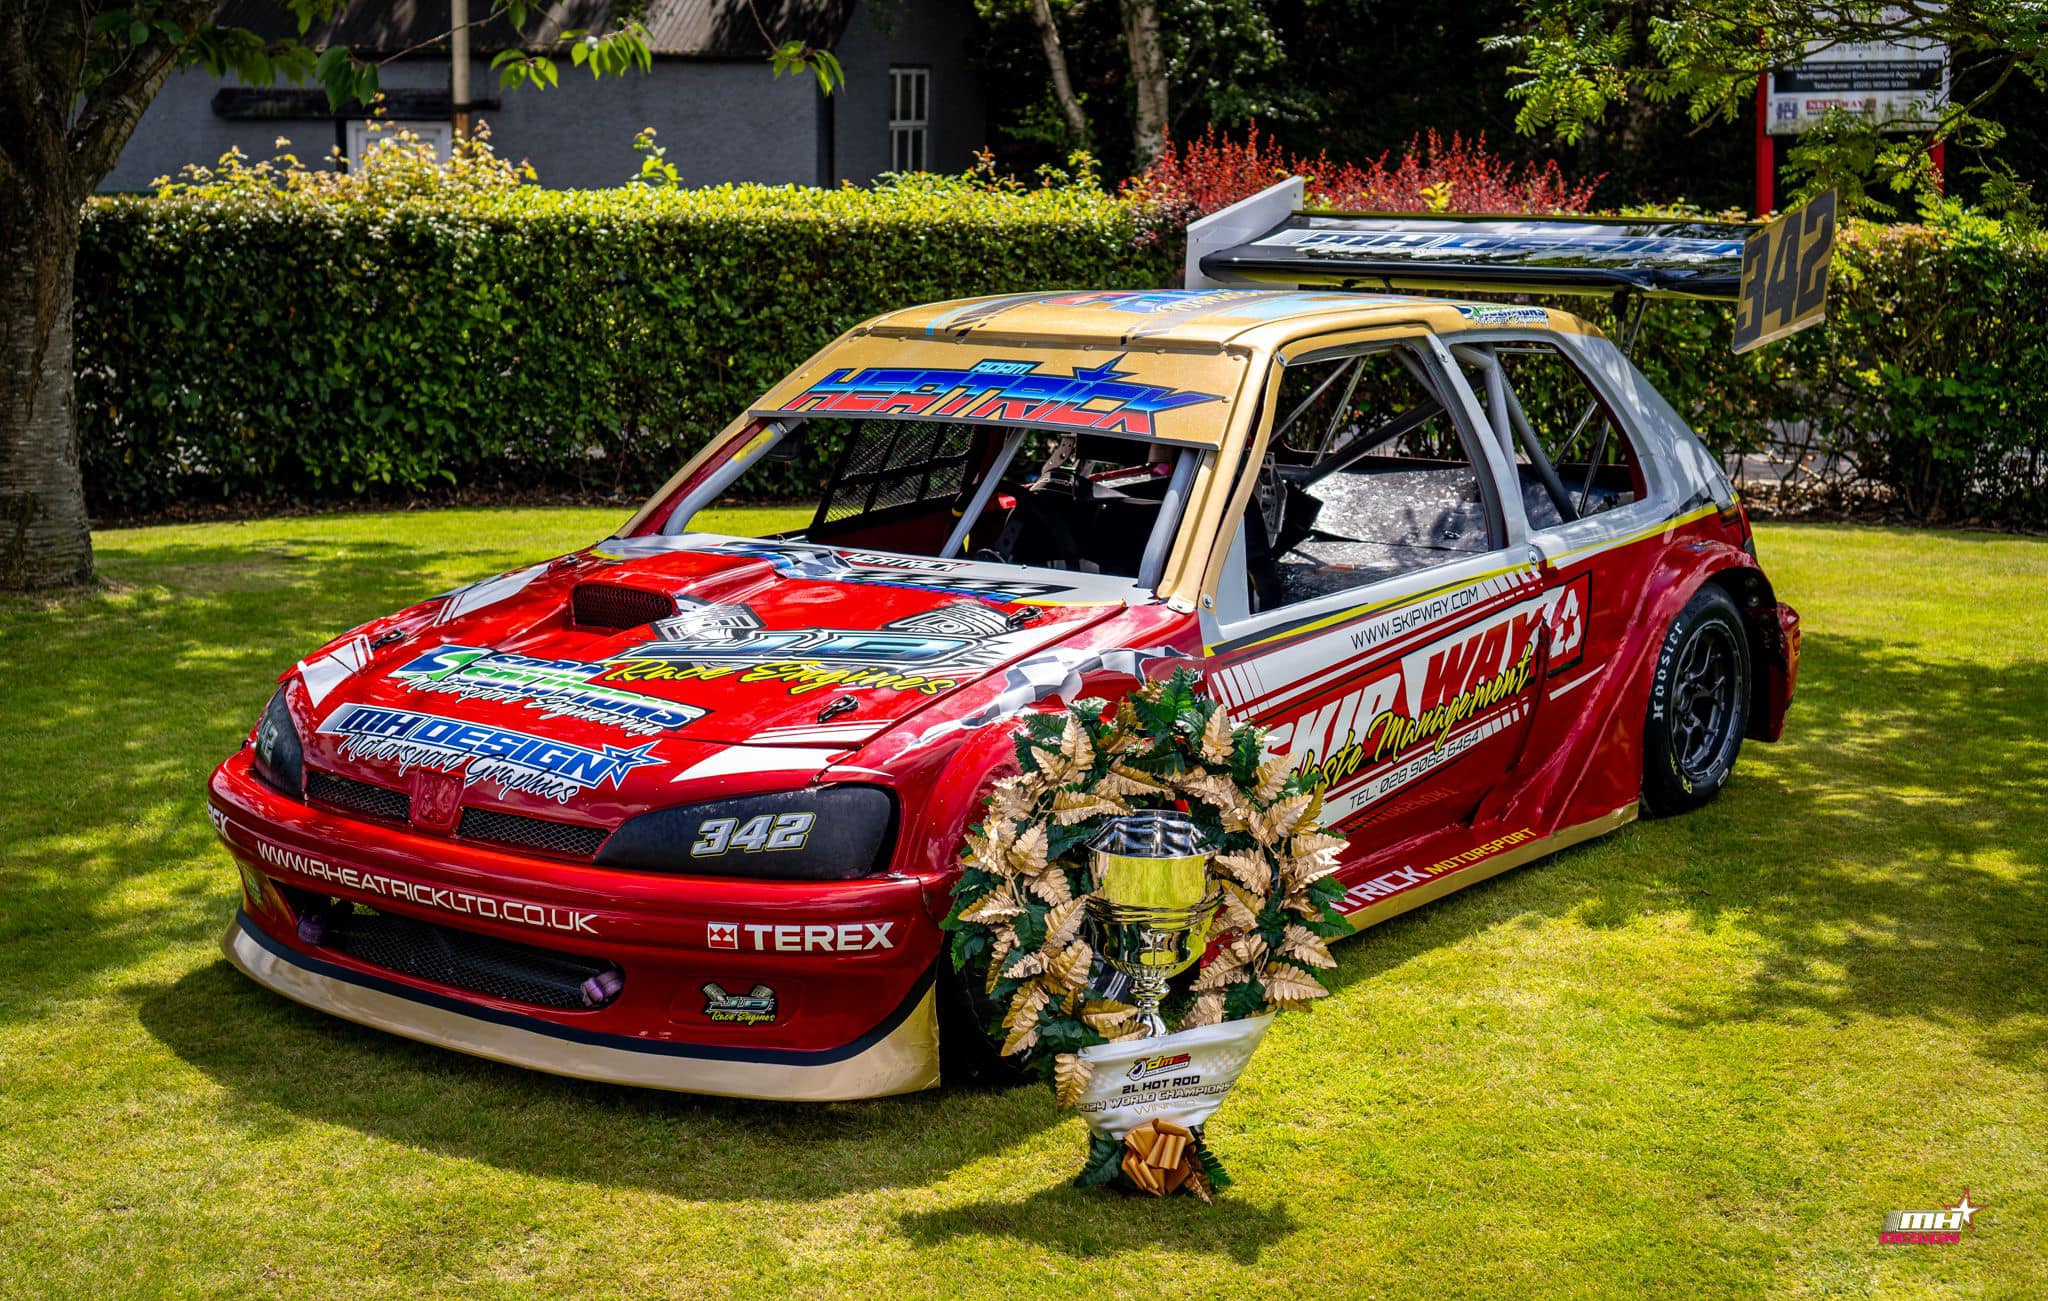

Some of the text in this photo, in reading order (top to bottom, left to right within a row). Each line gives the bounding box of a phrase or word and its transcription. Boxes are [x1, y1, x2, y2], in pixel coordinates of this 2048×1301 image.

[1733, 190, 1835, 349] 342
[970, 361, 1037, 375] ADAM
[778, 366, 1226, 437] HEATRICK
[849, 552, 964, 573] HEATRICK
[1350, 586, 1479, 650] WWW.SKIPWAY.COM
[604, 659, 957, 695] Race Engines
[1258, 607, 1545, 776] SKIP WAY
[1652, 621, 1684, 721] Hoosier
[446, 667, 707, 728] SOLUTIONS
[523, 694, 665, 738] Engineering
[1367, 642, 1533, 763] Management
[337, 707, 612, 784] MH DESIGN
[337, 728, 580, 804] Motorsport Graphics
[1379, 765, 1408, 794] 028
[691, 812, 816, 858] 342
[1423, 826, 1538, 877] MOTORSPORT
[257, 840, 599, 935] WWW.RHEATRICKLTD.CO.UK
[744, 921, 895, 952] TEREX
[707, 1010, 776, 1026] Race Engines
[1109, 1093, 1156, 1110] WORLD
[1122, 1075, 1201, 1095] 2L HOT ROD
